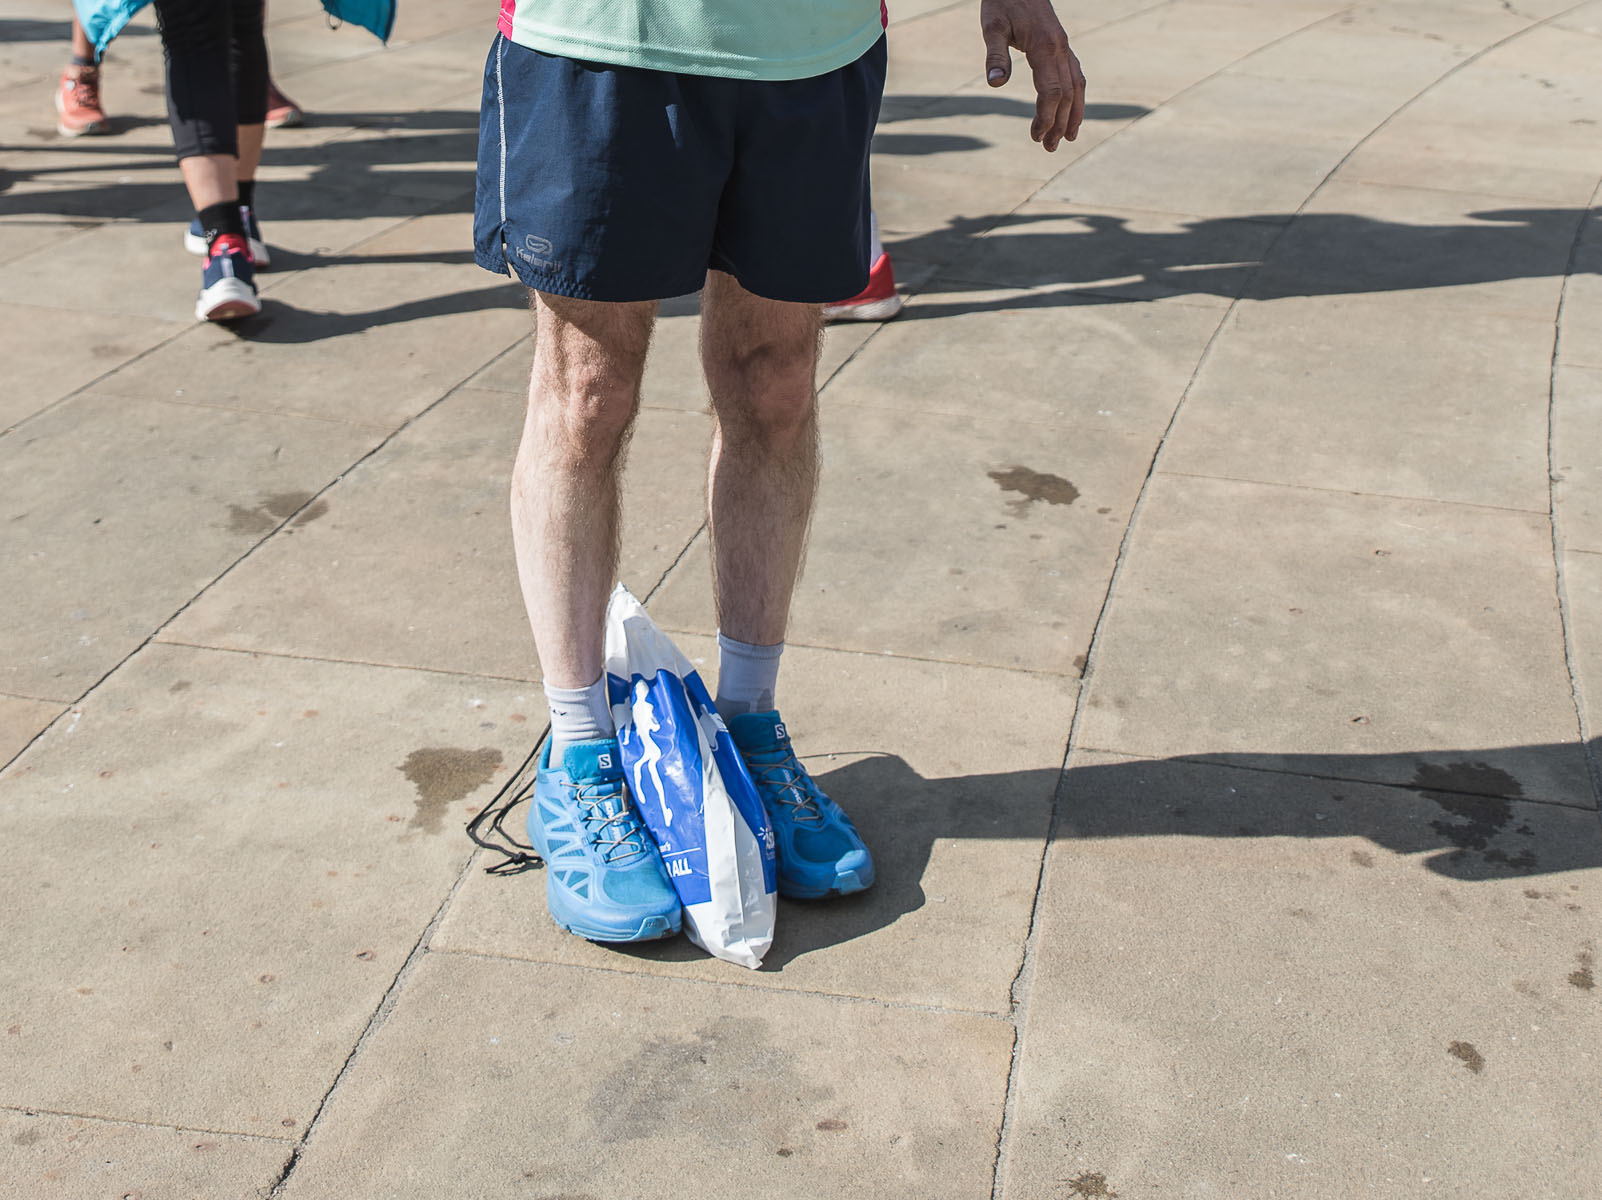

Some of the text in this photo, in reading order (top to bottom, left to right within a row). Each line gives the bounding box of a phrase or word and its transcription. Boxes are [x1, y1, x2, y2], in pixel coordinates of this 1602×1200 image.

[777, 726, 785, 738] S
[600, 756, 610, 768] S
[673, 857, 693, 877] ALL
